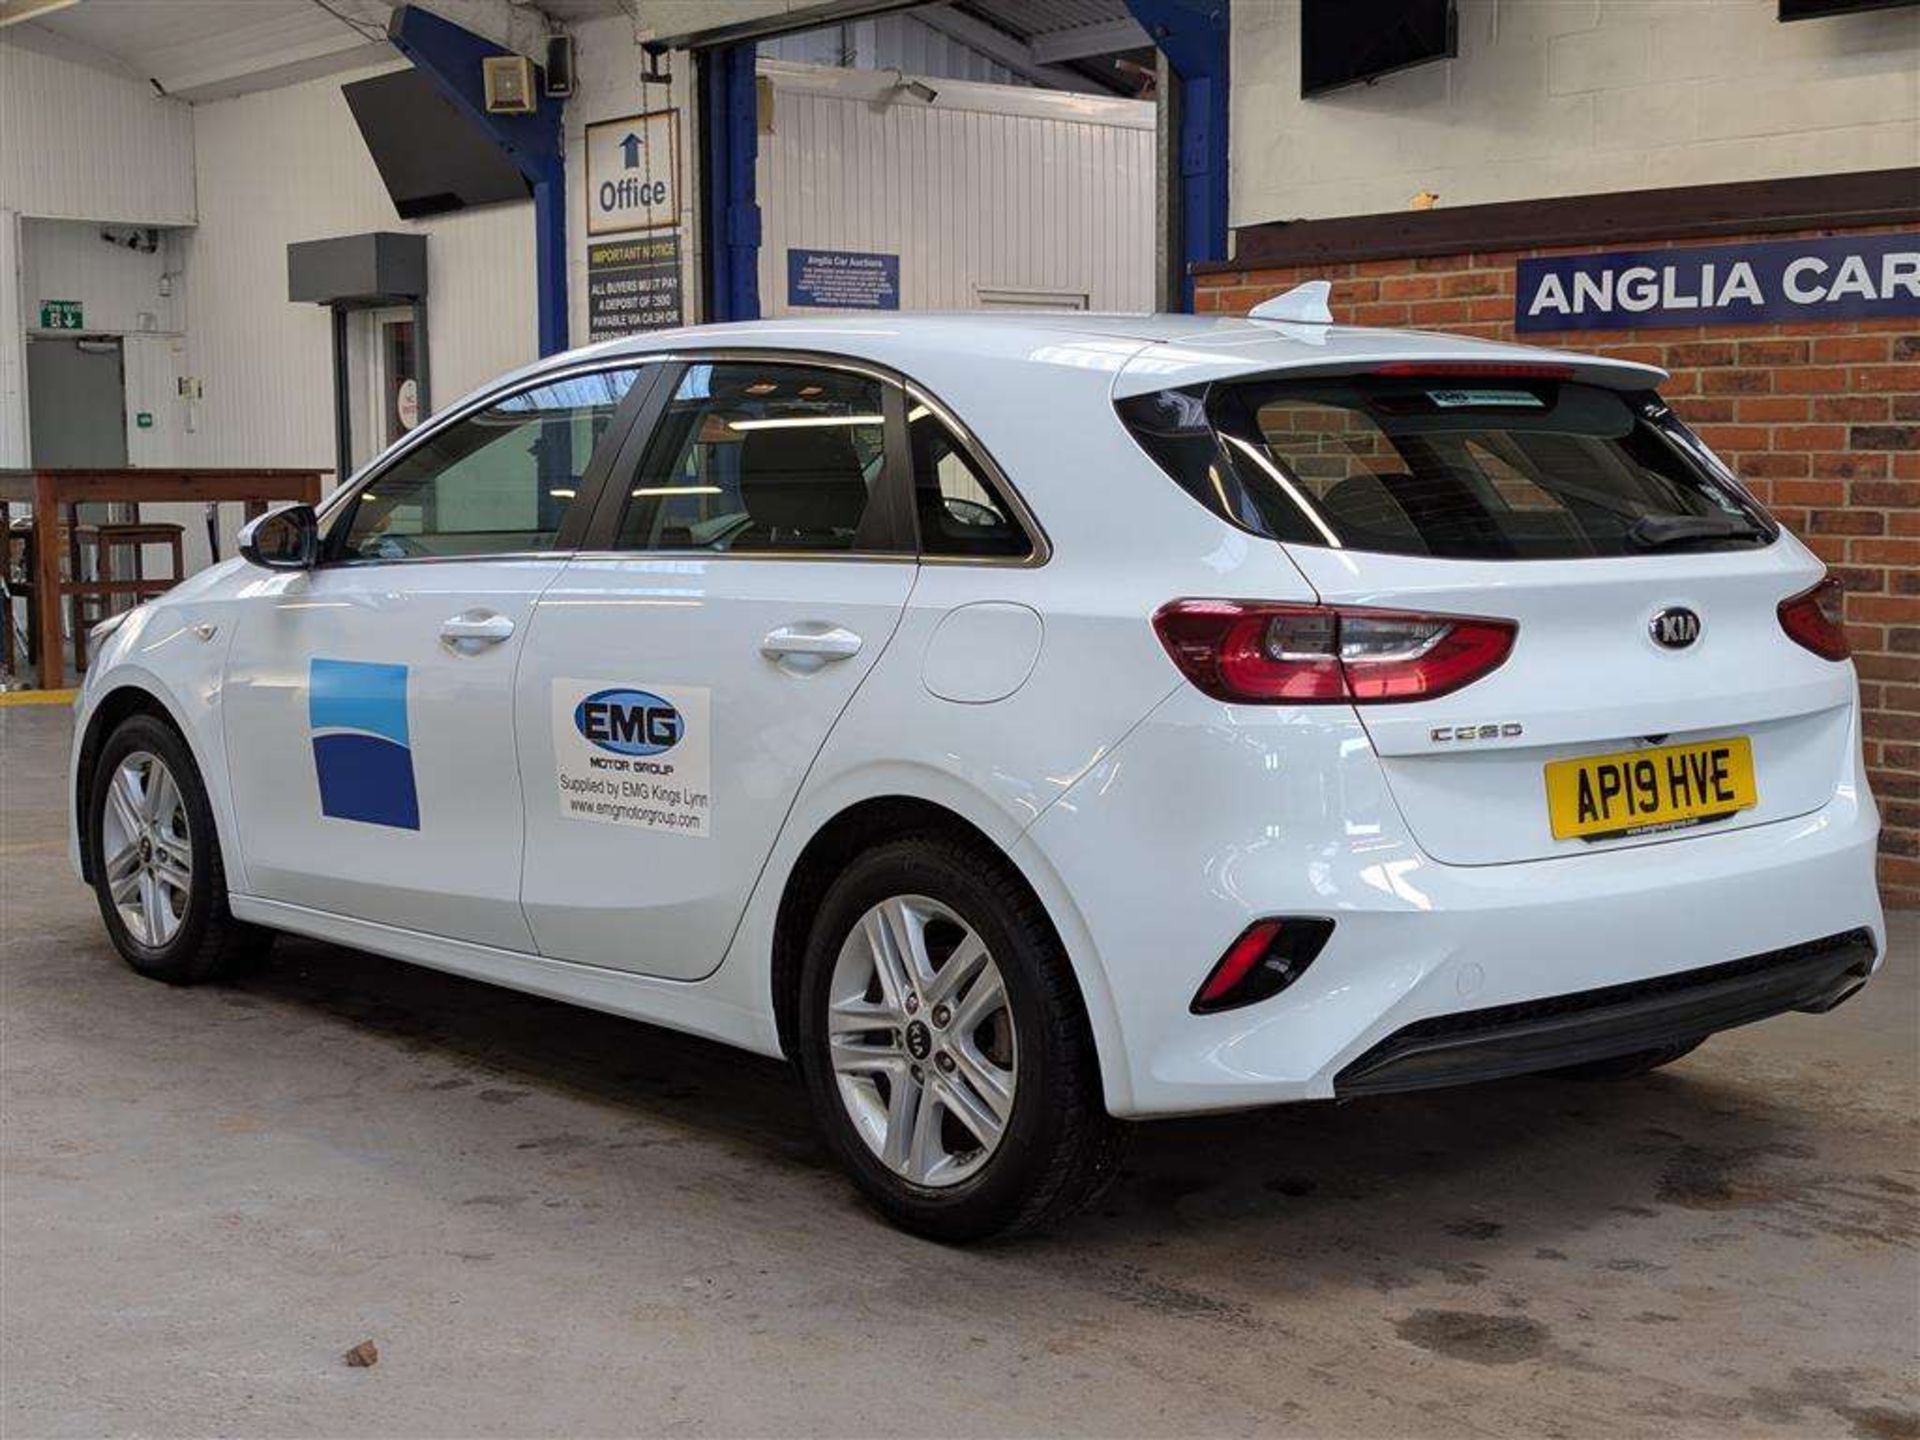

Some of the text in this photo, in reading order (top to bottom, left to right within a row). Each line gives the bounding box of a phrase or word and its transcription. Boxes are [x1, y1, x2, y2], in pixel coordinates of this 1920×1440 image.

[600, 178, 666, 213] Office
[592, 246, 641, 264] IMPORTANT
[834, 255, 848, 266] Car
[849, 257, 883, 268] Auctions
[592, 283, 605, 295] ALL
[607, 280, 637, 294] BUYERS
[1527, 252, 1920, 316] ANGLIA CAR
[605, 297, 638, 310] DEPOSIT
[592, 314, 627, 327] PAYABLE
[628, 313, 640, 325] VIA
[1661, 615, 1697, 642] KIA
[584, 702, 678, 747] EMG
[590, 757, 674, 776] MOTOR GROUP
[560, 773, 708, 808] Supplied by EMG Kings Lynn
[1578, 748, 1735, 824] AP19 HVE
[570, 799, 701, 829] www.emgmotorgroup.com
